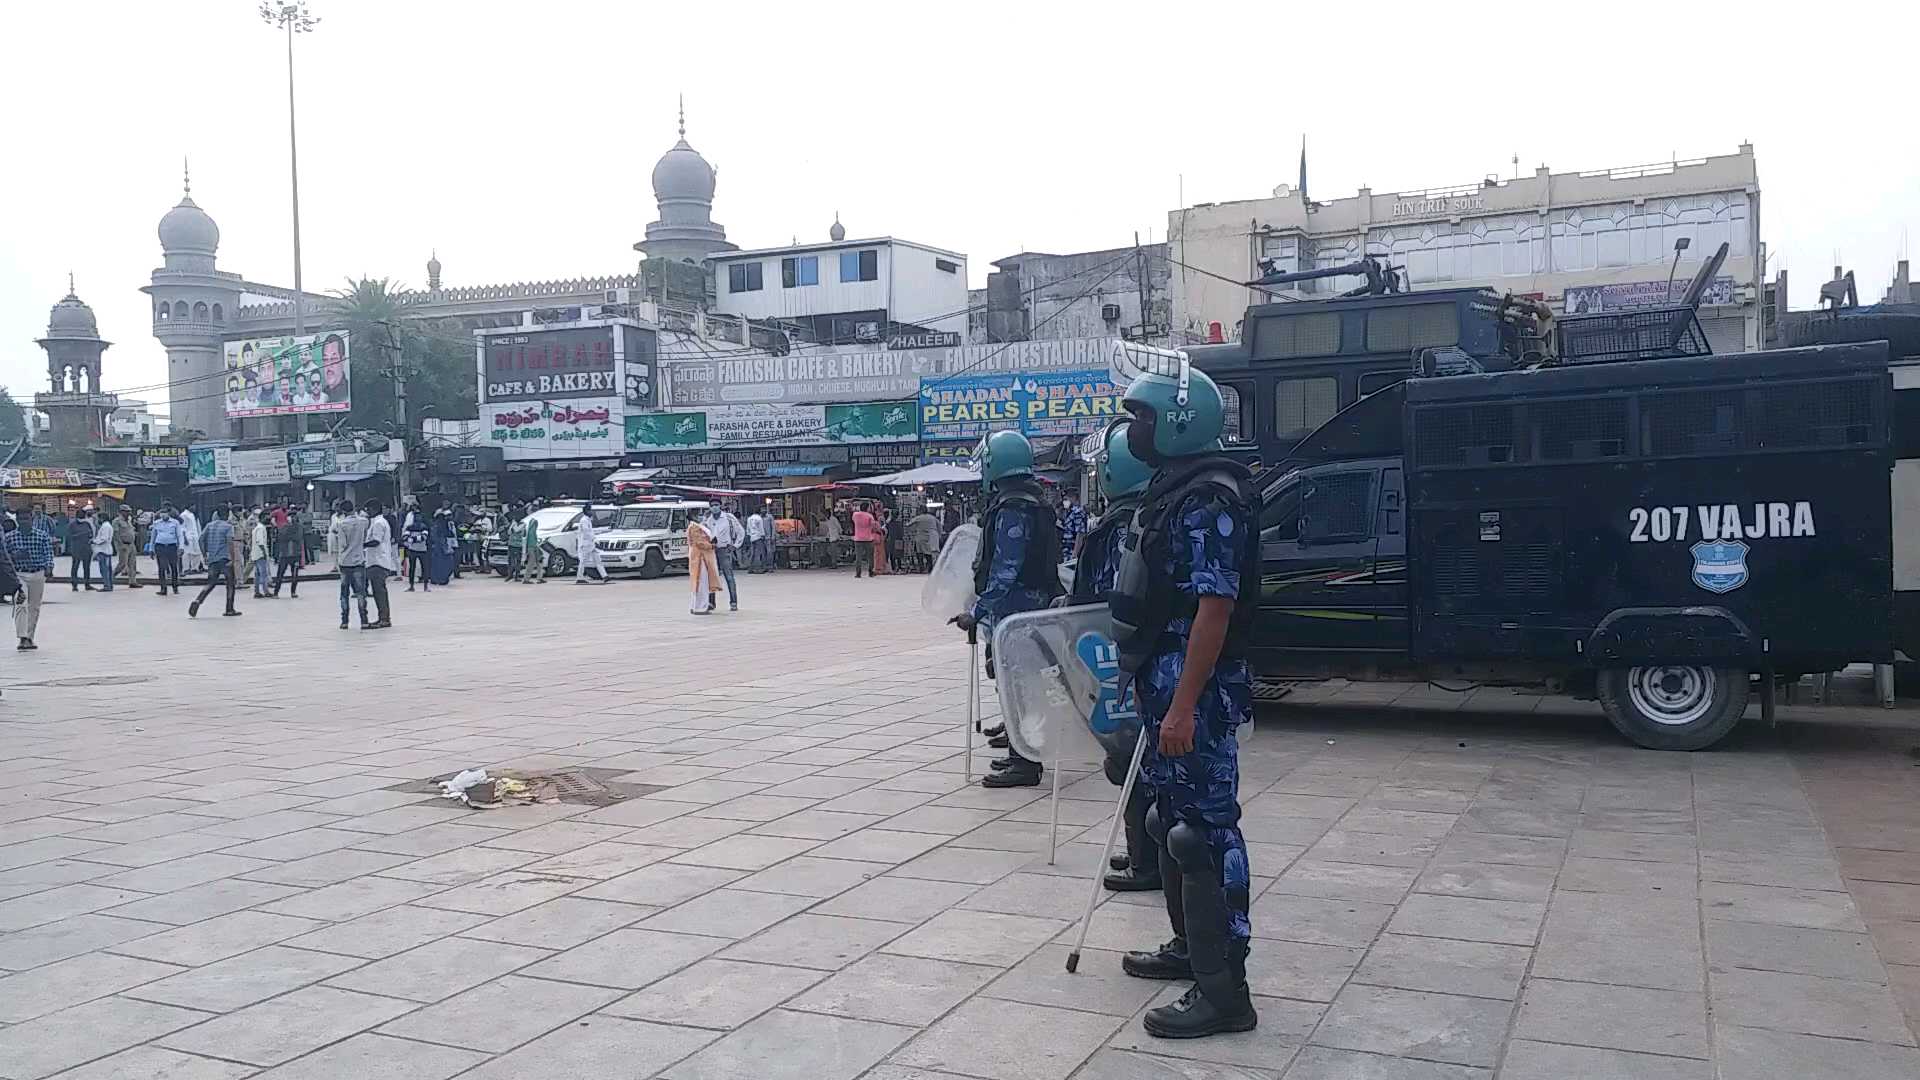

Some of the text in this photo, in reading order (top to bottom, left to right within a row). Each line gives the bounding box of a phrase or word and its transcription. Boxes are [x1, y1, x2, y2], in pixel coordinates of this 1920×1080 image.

[1393, 200, 1414, 216] BIN
[898, 334, 954, 348] HALEEM
[719, 357, 785, 384] FARASHA
[788, 355, 824, 380] CAFE
[828, 358, 839, 378] &
[842, 351, 903, 377] BAKERY
[945, 343, 1003, 373] FAMILY
[1010, 337, 1113, 368] RESTAURAN
[525, 381, 536, 394] &
[539, 372, 615, 394] BAKERY
[1036, 383, 1124, 400] SHAADA
[931, 387, 1013, 406] SHAADAN
[883, 410, 906, 428] Sprite
[923, 401, 1020, 423] PEARLS
[1166, 409, 1197, 422] RAF
[709, 417, 822, 432] FARASHA CAFE & BAKERY
[720, 429, 812, 440] FAMILY RESTAURANT
[1629, 501, 1816, 542] 207 VAJRA
